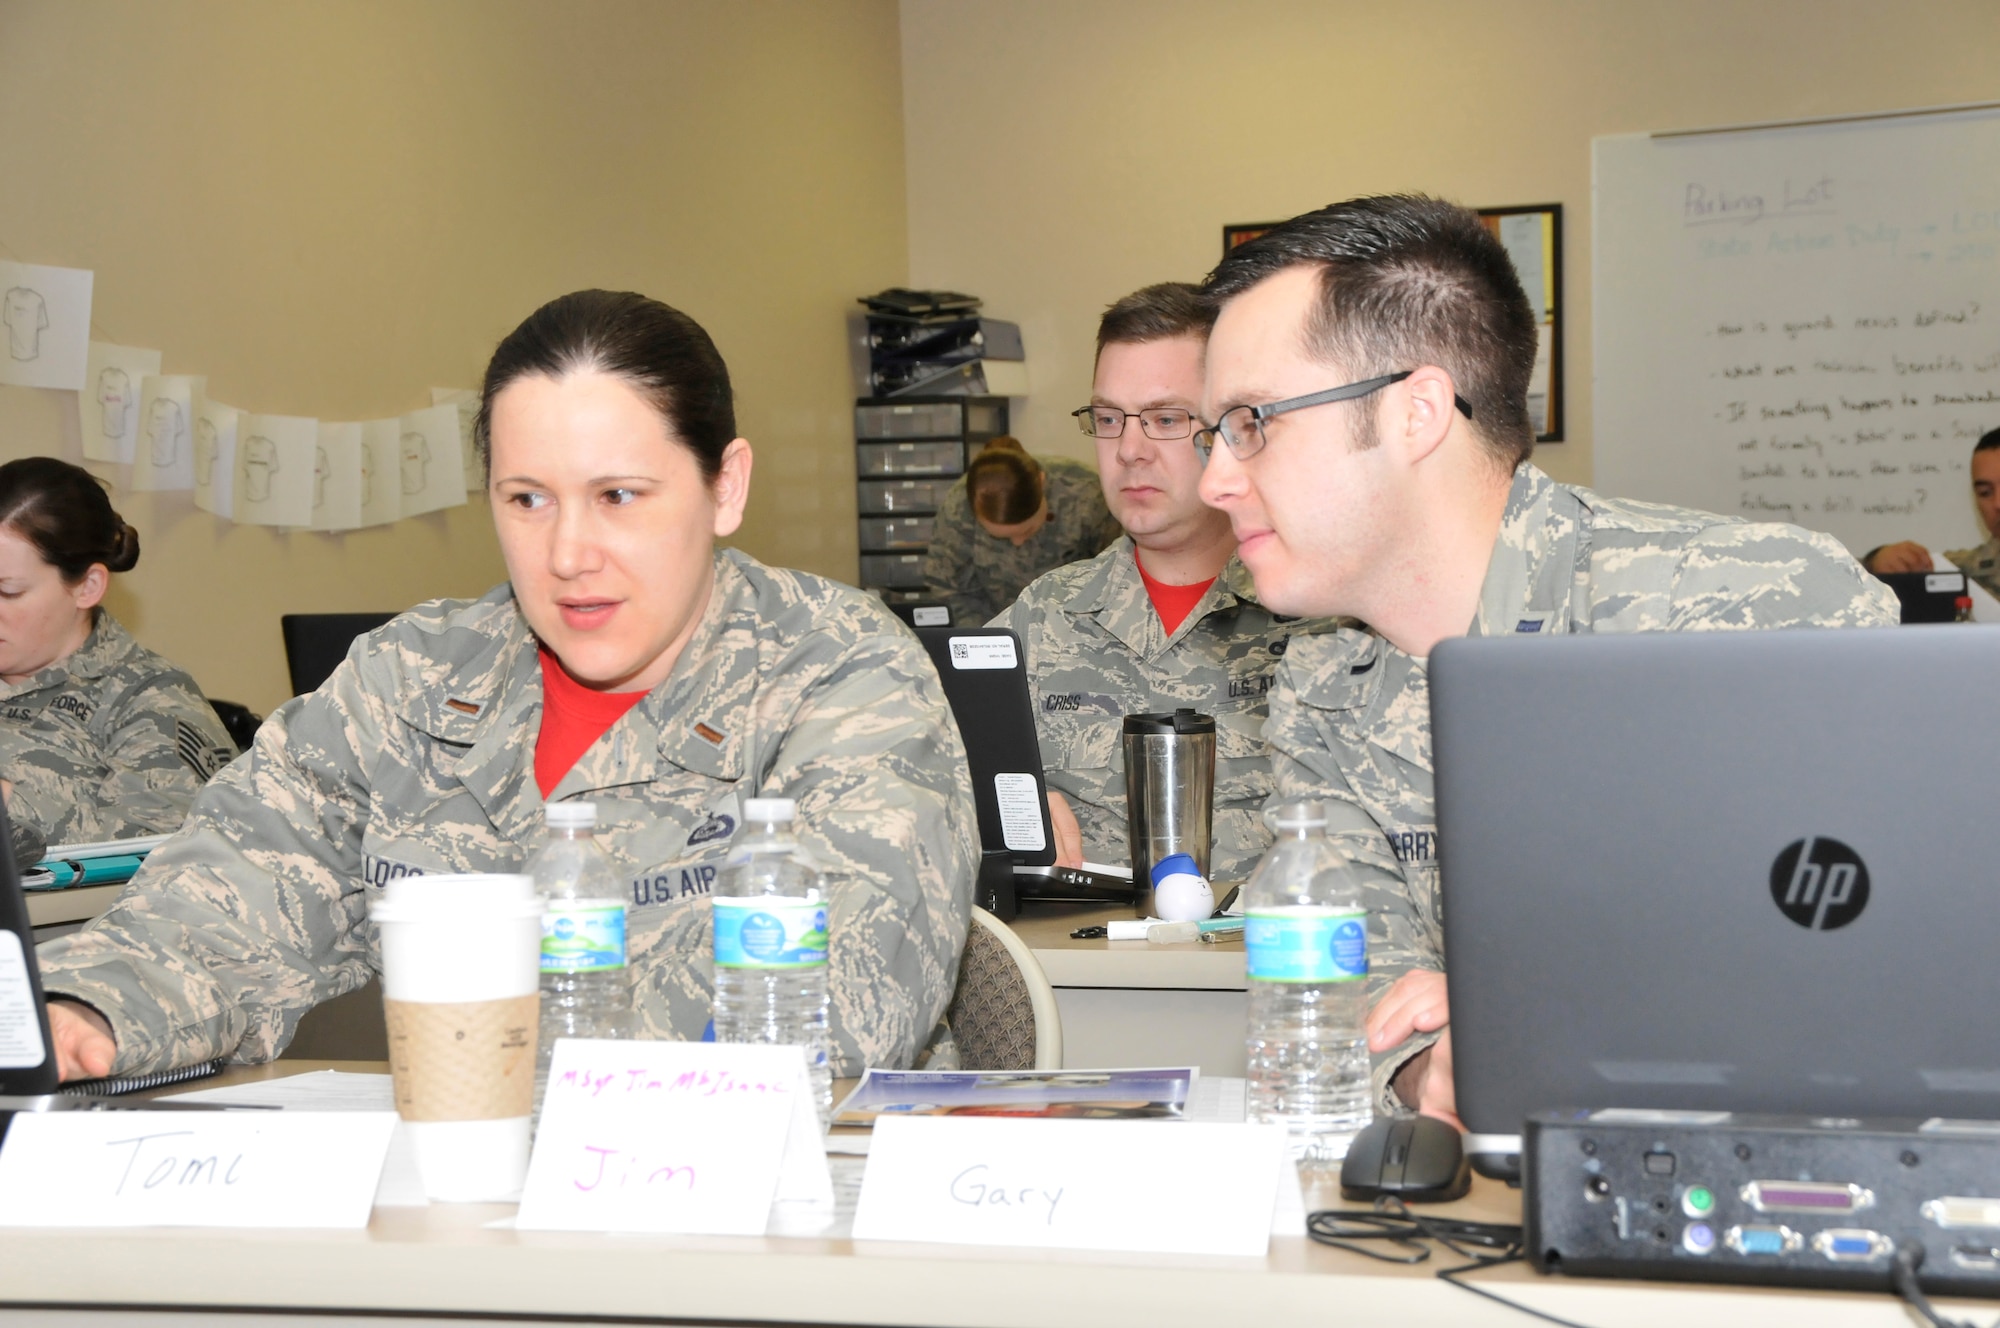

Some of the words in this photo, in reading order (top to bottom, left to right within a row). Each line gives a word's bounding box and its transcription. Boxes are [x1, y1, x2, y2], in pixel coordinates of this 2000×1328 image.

[1784, 175, 1834, 209] Lot
[1046, 694, 1081, 711] CRISS
[1229, 679, 1254, 698] U.S.
[1259, 676, 1273, 694] AI
[7, 706, 32, 721] U.S.
[50, 694, 93, 722] FORCE
[633, 875, 674, 906] U.S.
[1785, 838, 1858, 930] hp
[573, 1145, 696, 1192] Jim
[950, 1164, 1065, 1225] Gary
